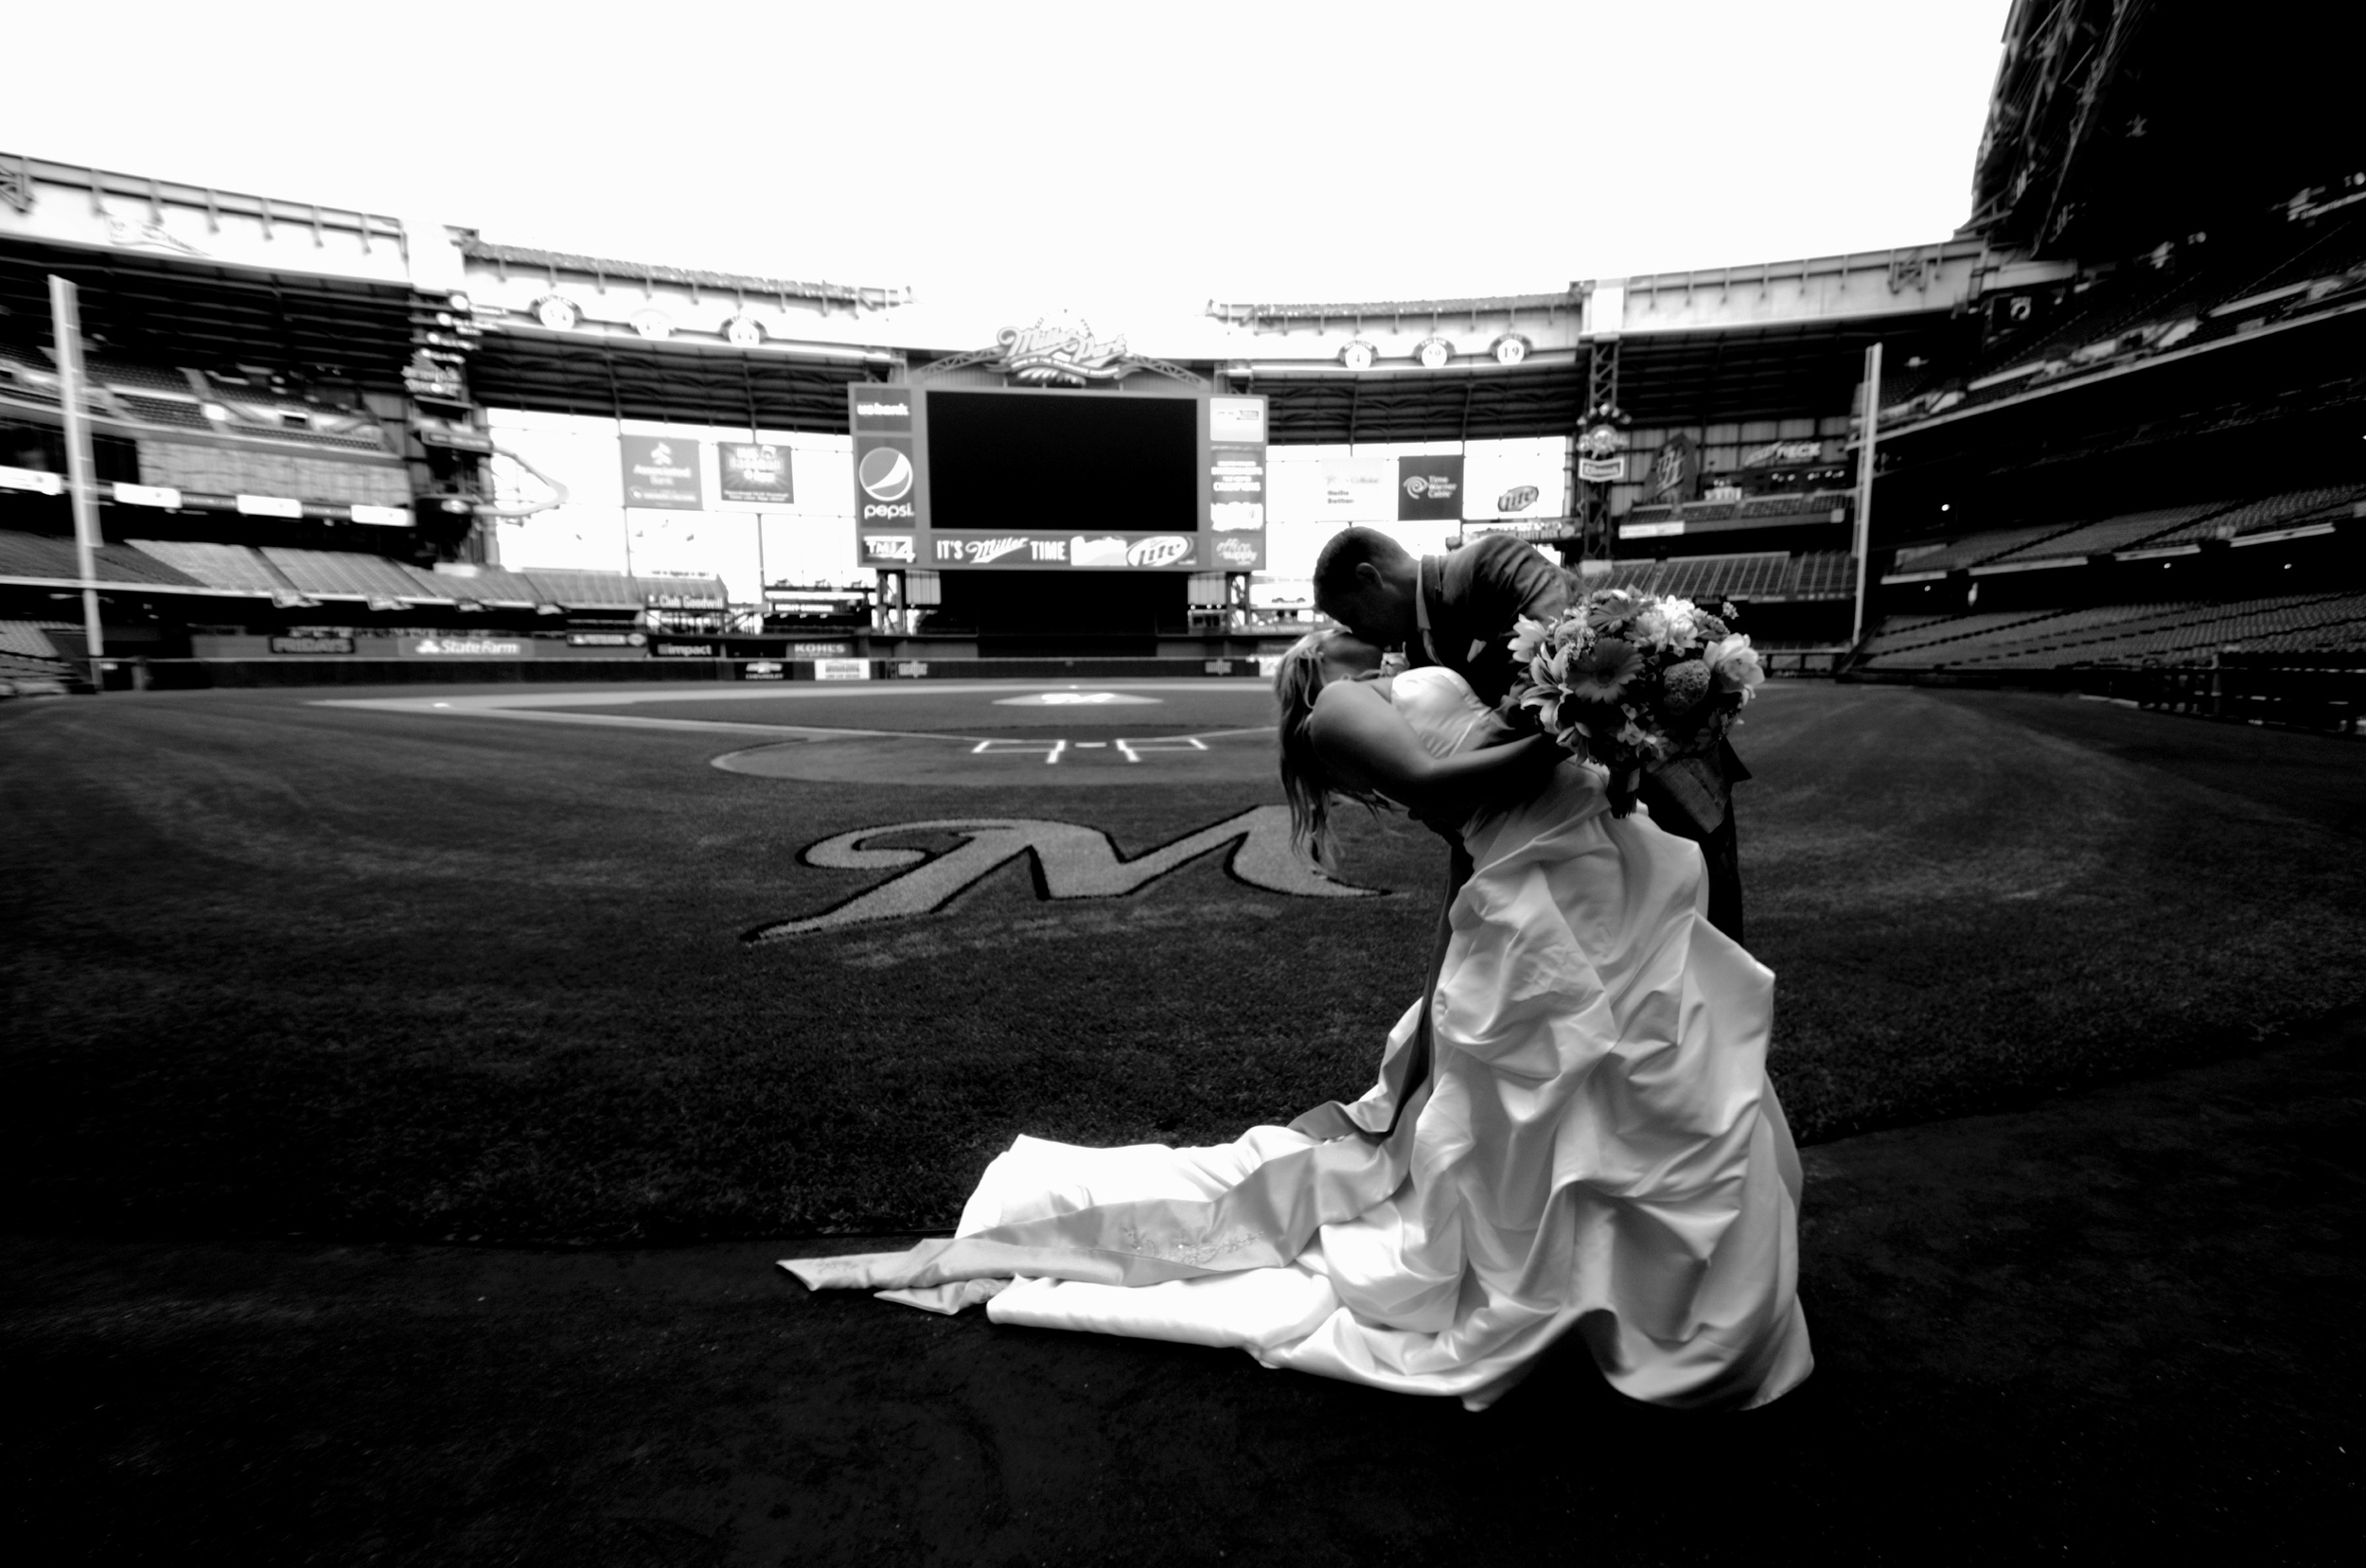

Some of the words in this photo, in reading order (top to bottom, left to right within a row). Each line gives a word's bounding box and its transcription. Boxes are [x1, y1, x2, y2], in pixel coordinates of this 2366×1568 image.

[997, 326, 1080, 359] Miller
[1062, 333, 1127, 368] Park
[1428, 490, 1453, 499] Cable
[863, 502, 913, 520] pepsi
[937, 540, 963, 559] IT'S
[965, 537, 1030, 564] Miller
[1030, 540, 1066, 560] TIME
[660, 594, 681, 608] Club
[683, 594, 724, 609] Goodwill
[440, 639, 481, 655] State
[480, 639, 520, 655] Farm
[667, 644, 713, 658] impact
